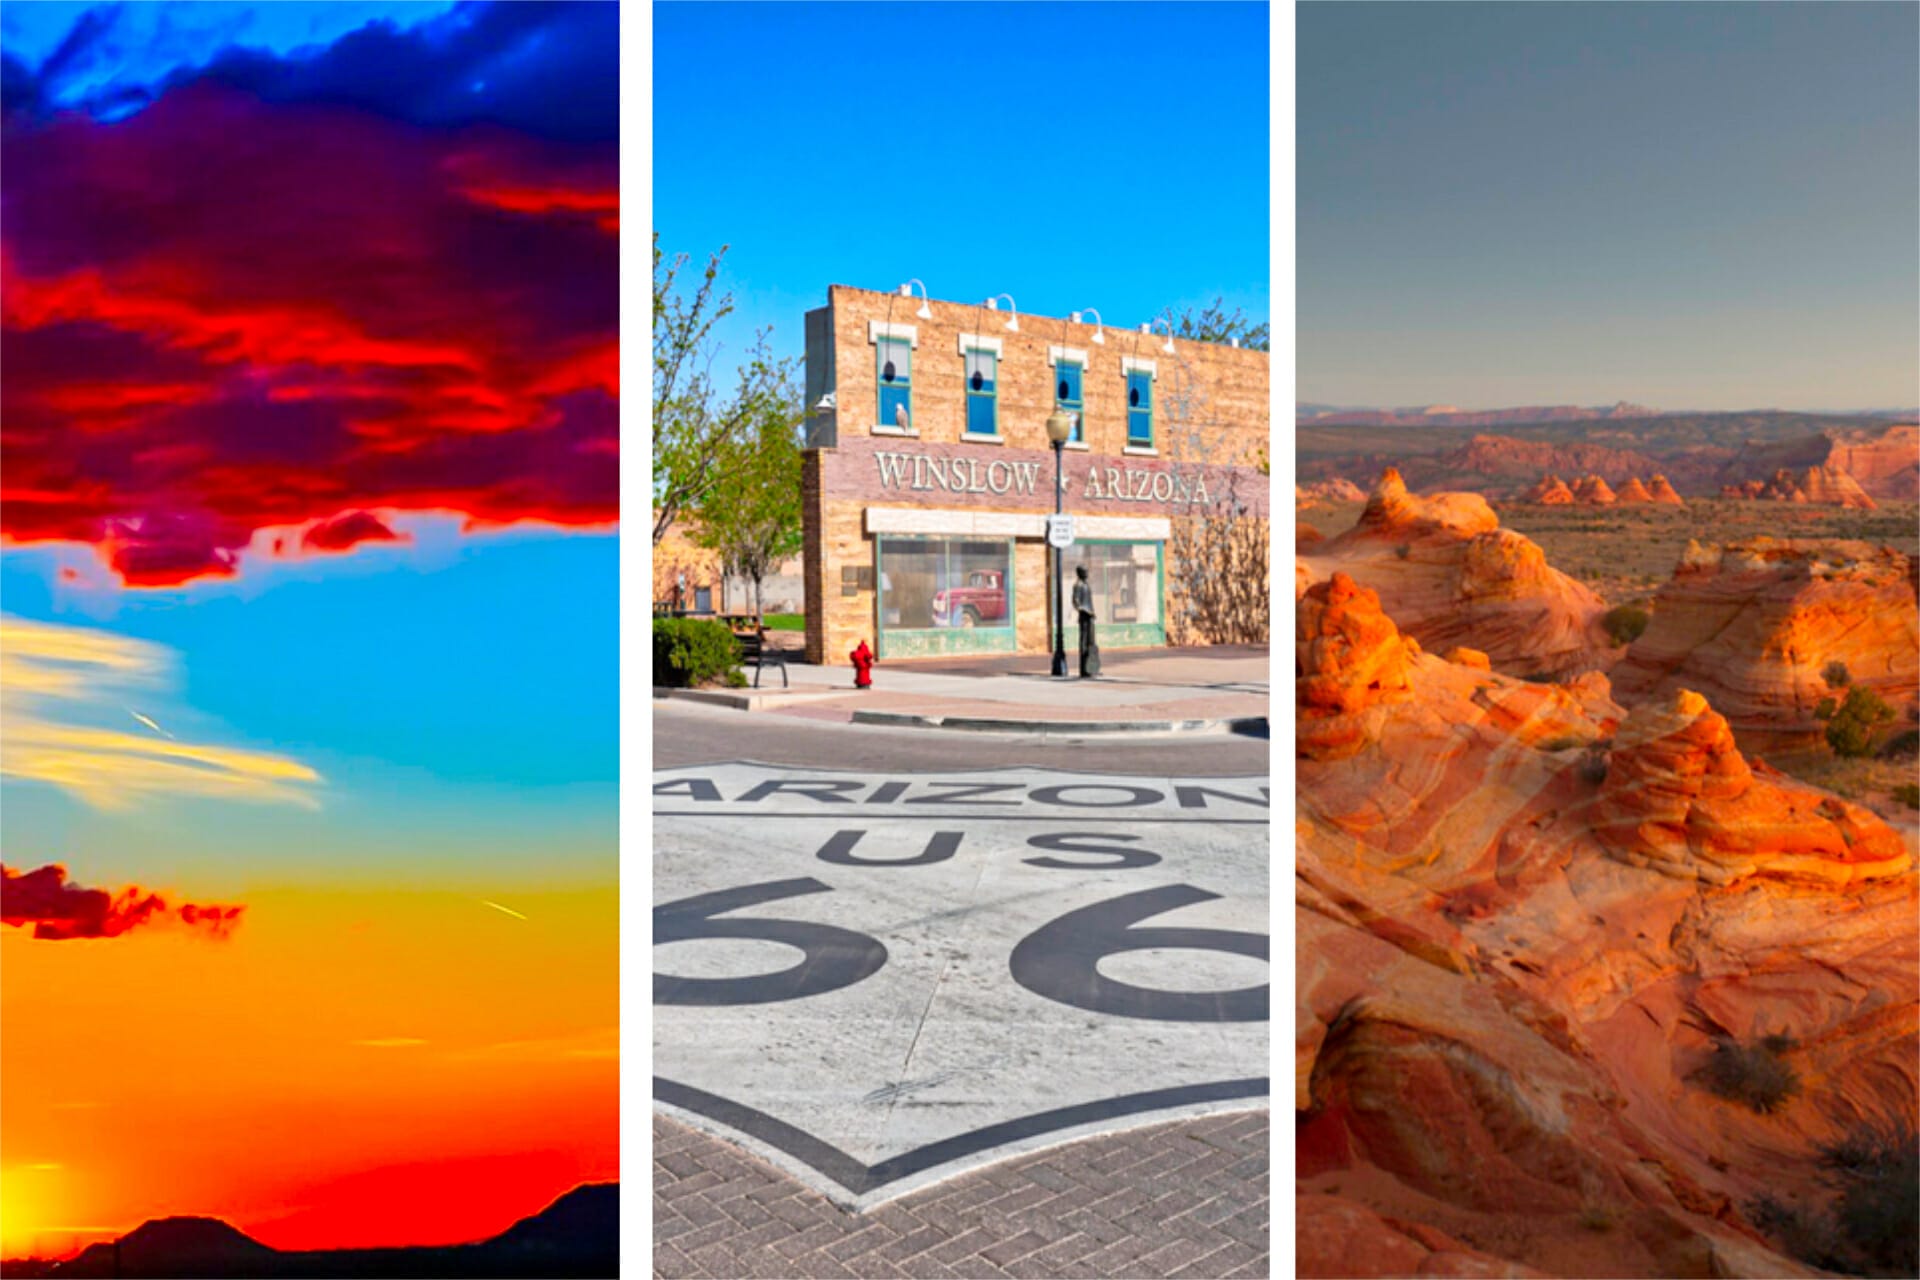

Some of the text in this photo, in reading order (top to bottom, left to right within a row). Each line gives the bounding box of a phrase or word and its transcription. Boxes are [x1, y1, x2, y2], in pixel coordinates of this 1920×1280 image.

[874, 452, 1210, 504] WINSLOW ARIZONA
[653, 877, 1270, 1022] 66
